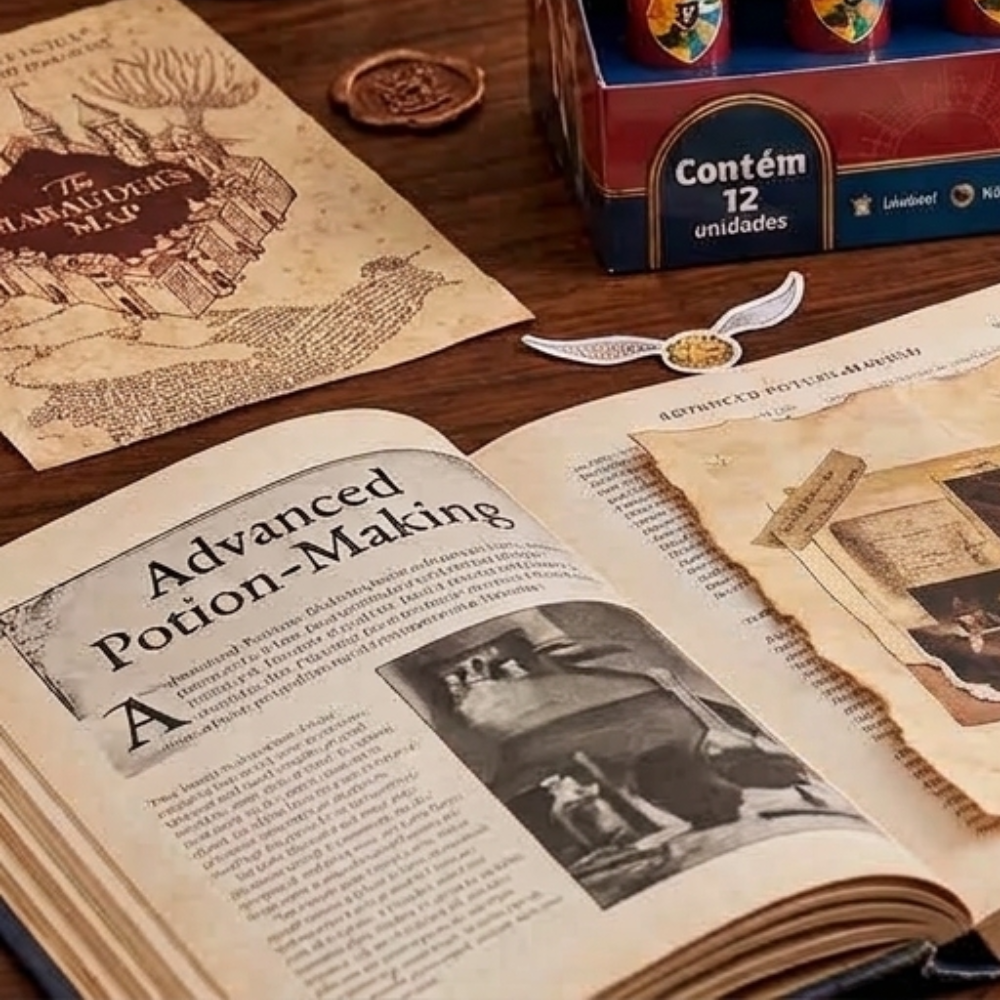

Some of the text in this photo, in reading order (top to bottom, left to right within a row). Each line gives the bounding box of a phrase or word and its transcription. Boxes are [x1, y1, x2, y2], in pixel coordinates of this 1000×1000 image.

[674, 147, 807, 187] Contém
[722, 185, 760, 214] 12
[693, 213, 789, 240] unidades
[148, 466, 405, 601] Advanced
[88, 499, 516, 673] Potion-Making
[102, 695, 194, 754] A
